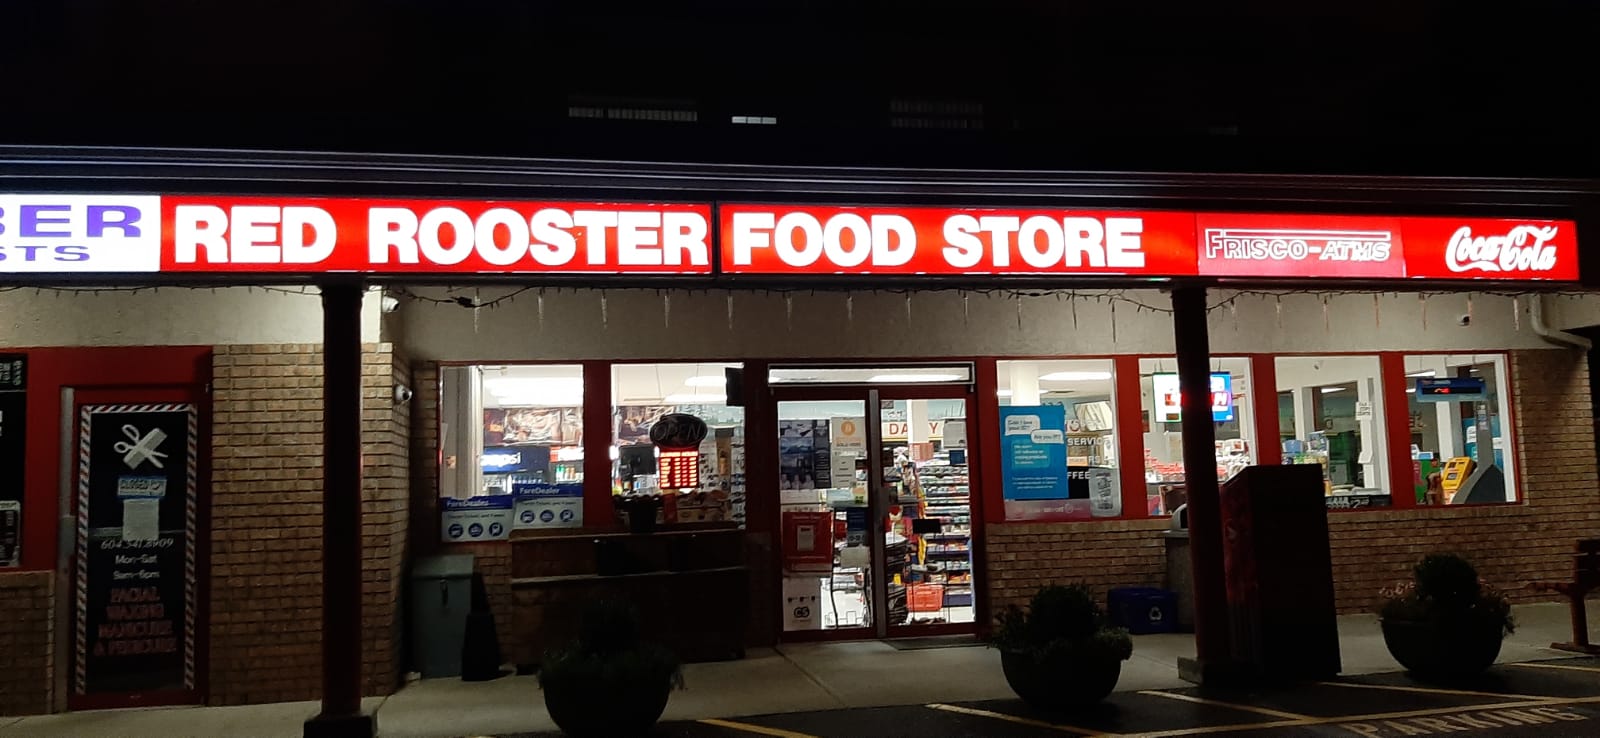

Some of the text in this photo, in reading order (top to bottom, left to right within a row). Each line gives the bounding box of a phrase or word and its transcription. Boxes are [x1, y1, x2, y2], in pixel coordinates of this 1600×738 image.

[0, 204, 142, 238] ER
[174, 204, 709, 266] RED ROOSTER
[732, 211, 1145, 268] FOOD STORE
[1444, 226, 1558, 273] Coca-Cola
[654, 423, 701, 442] OPEN
[1341, 707, 1588, 738] PARKING
